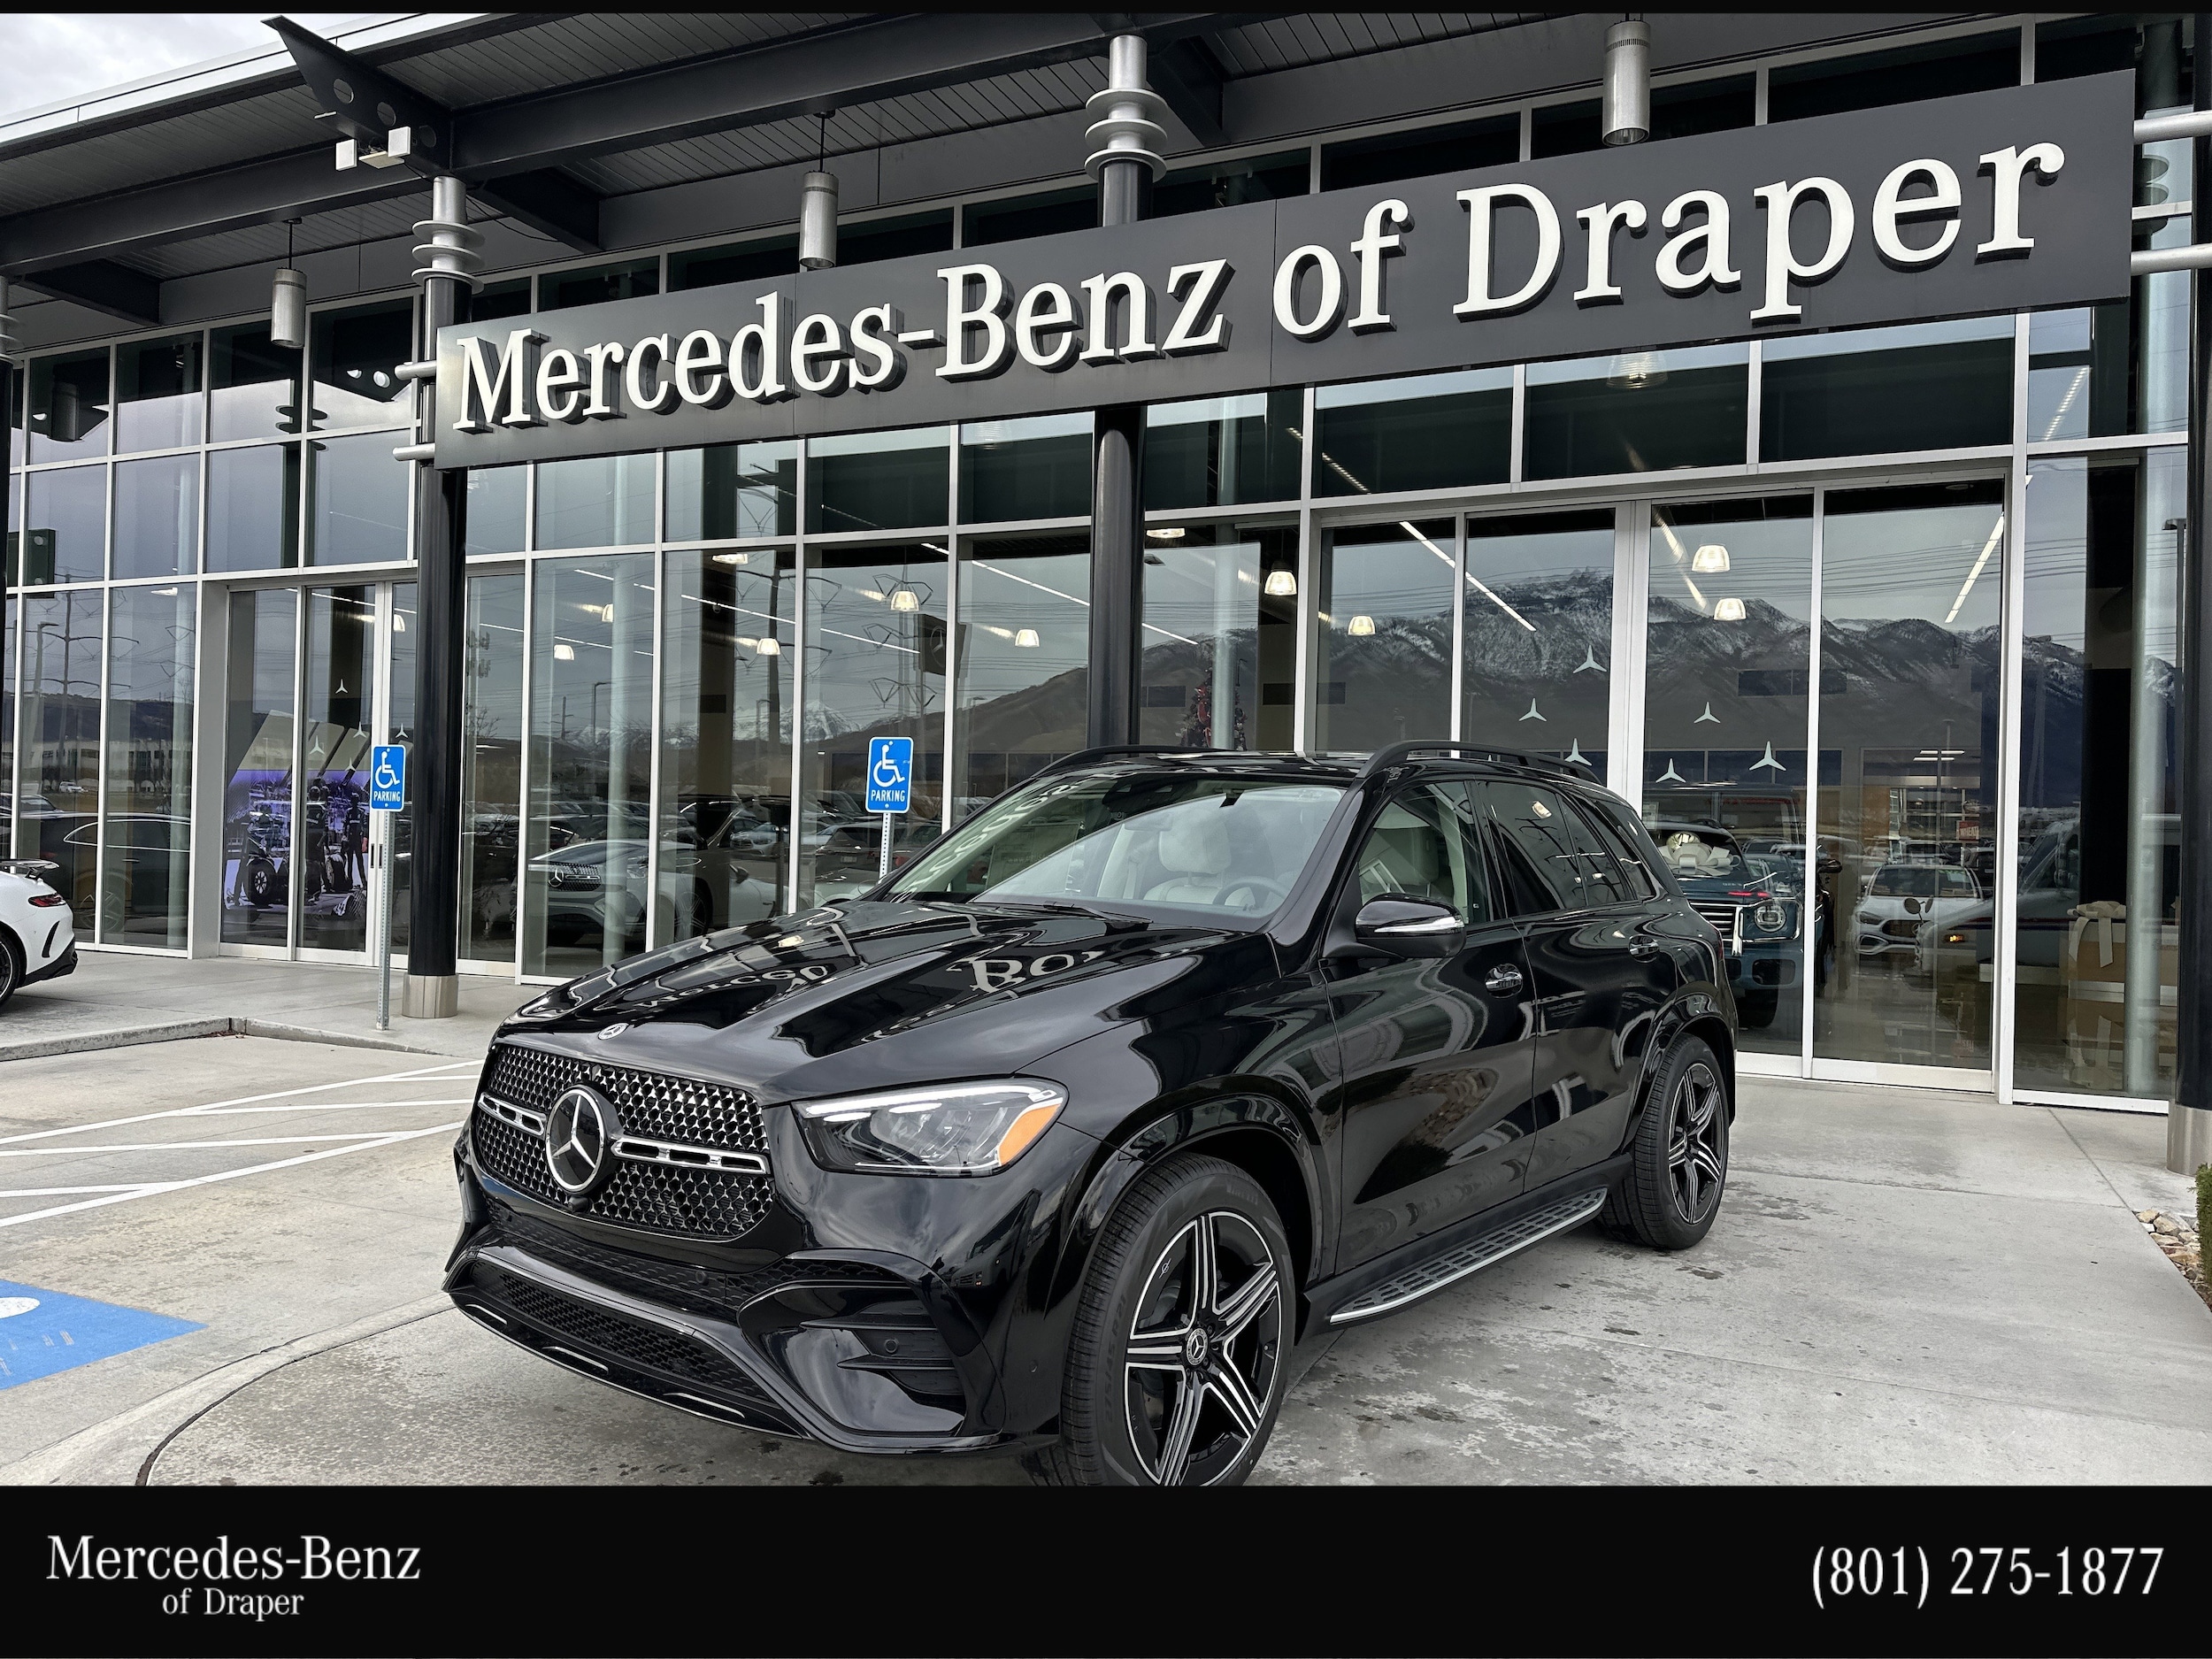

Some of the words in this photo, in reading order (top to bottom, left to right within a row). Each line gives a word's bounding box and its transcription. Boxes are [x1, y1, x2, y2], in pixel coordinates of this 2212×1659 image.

[453, 258, 1232, 433] Mercedes-Benz
[1273, 198, 1410, 338] of
[1453, 142, 2066, 321] Draper
[373, 791, 401, 803] PARKING
[872, 789, 906, 803] PARKING
